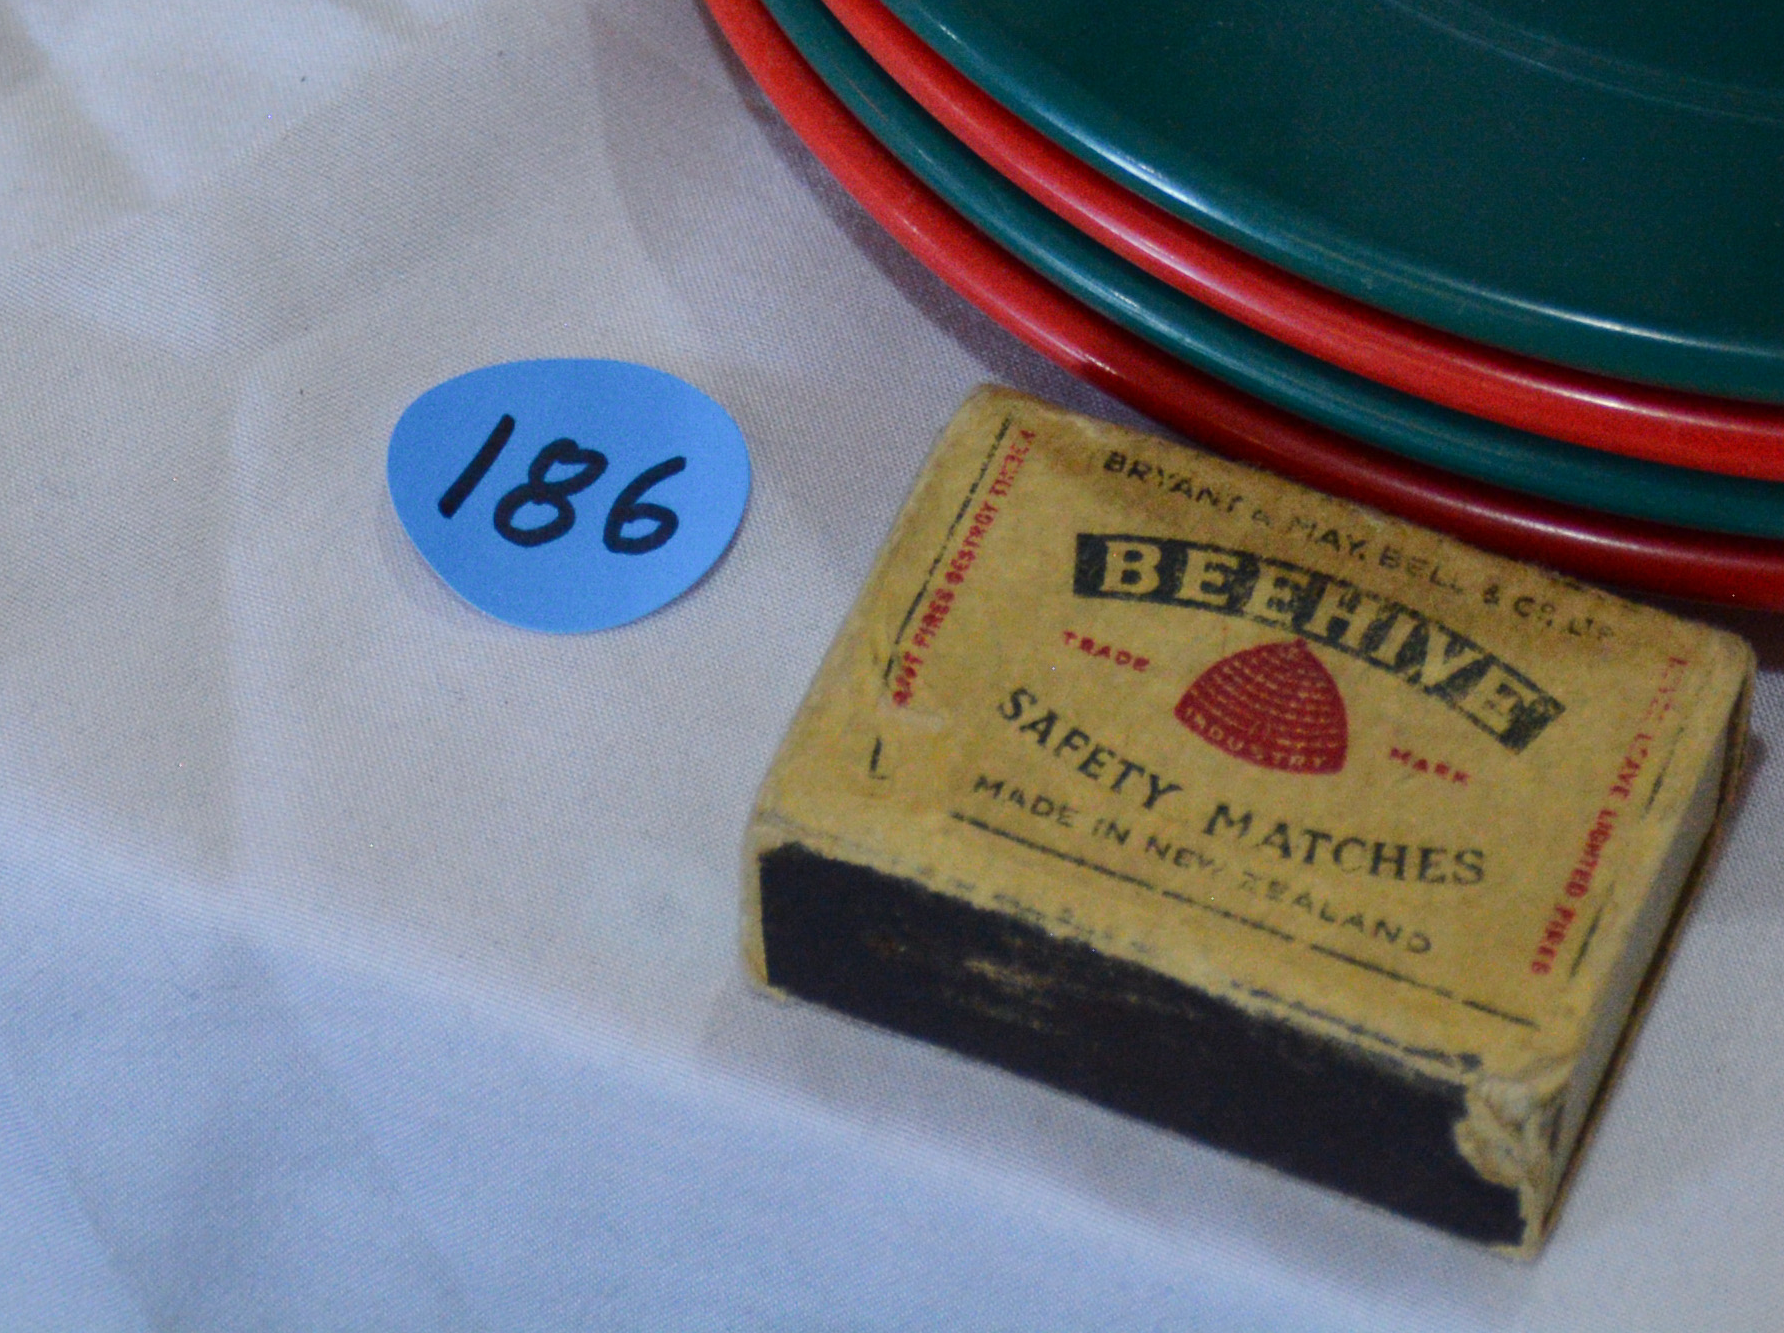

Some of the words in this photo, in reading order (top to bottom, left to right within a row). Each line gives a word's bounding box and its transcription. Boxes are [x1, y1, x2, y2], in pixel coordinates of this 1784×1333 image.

[437, 413, 688, 556] 186
[1103, 450, 1245, 513] BRYANT
[1060, 630, 1151, 673] TRADE
[1389, 747, 1472, 786] MARK
[1095, 537, 1545, 738] BEEHIVE
[973, 774, 1081, 829] MADE
[1091, 816, 1132, 847] IN
[1144, 835, 1223, 877] NEW
[1236, 870, 1433, 955] ZEALAND
[996, 686, 1184, 812] SAFETY
[1201, 803, 1487, 887] MATCHES
